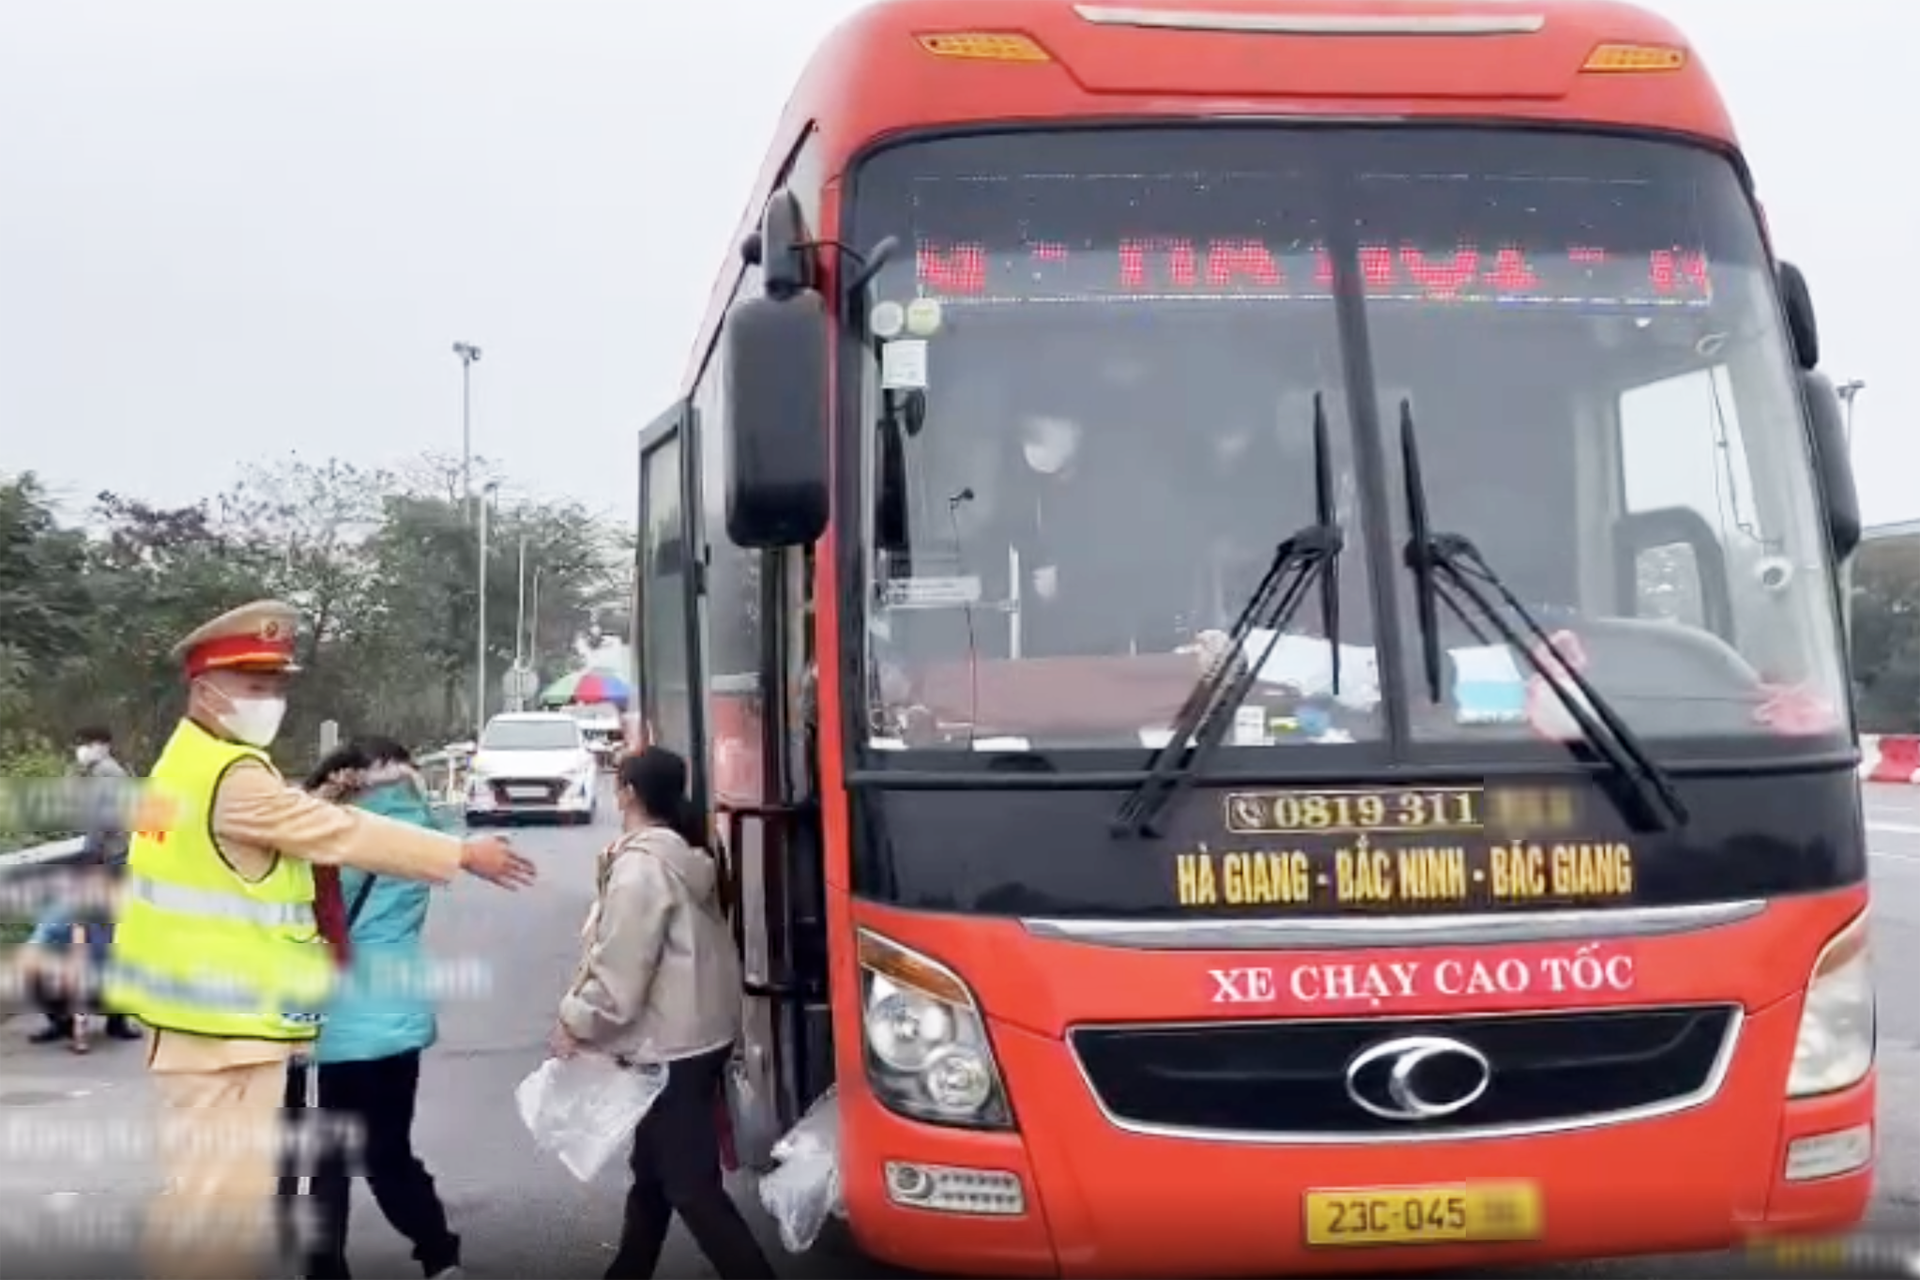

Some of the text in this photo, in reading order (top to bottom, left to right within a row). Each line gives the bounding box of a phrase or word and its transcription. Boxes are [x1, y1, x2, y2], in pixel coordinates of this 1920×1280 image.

[1273, 795, 1385, 828] 0819
[1397, 791, 1473, 825] 311
[1177, 841, 1216, 904] HÀ
[1223, 850, 1310, 903] GIANG
[1335, 833, 1392, 900] BẮC
[1399, 846, 1466, 899] NINH
[1552, 843, 1632, 894] GIANG
[1209, 942, 1633, 1006] XE CHẠY CAO TỐC
[1326, 1197, 1518, 1233] 23C-045
